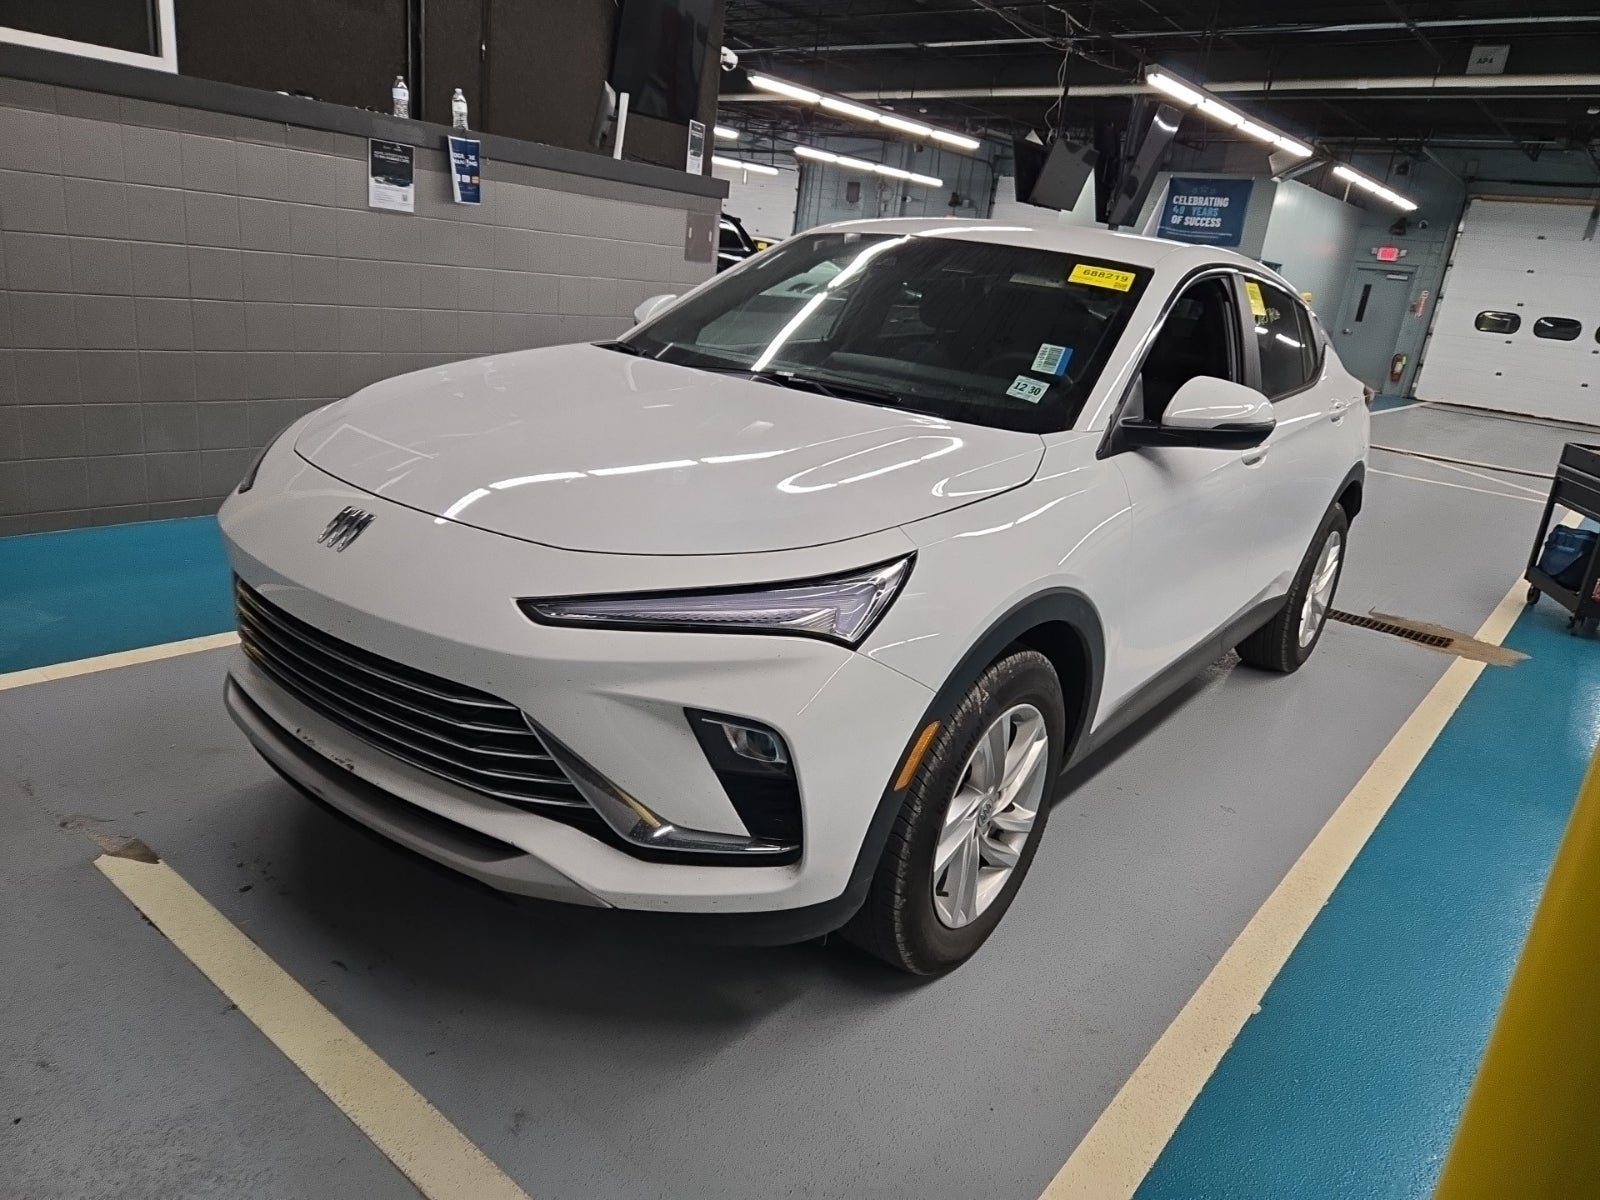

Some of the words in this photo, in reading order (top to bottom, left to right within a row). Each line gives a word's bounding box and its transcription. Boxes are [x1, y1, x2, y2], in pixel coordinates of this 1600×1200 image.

[1173, 195, 1229, 207] CELEBRATING
[1192, 207, 1218, 216] YEARS
[1171, 215, 1184, 224] OF
[1184, 216, 1221, 227] SUCCESS
[1083, 269, 1128, 282] 688219
[1014, 382, 1028, 391] 12
[1028, 386, 1041, 395] 30
